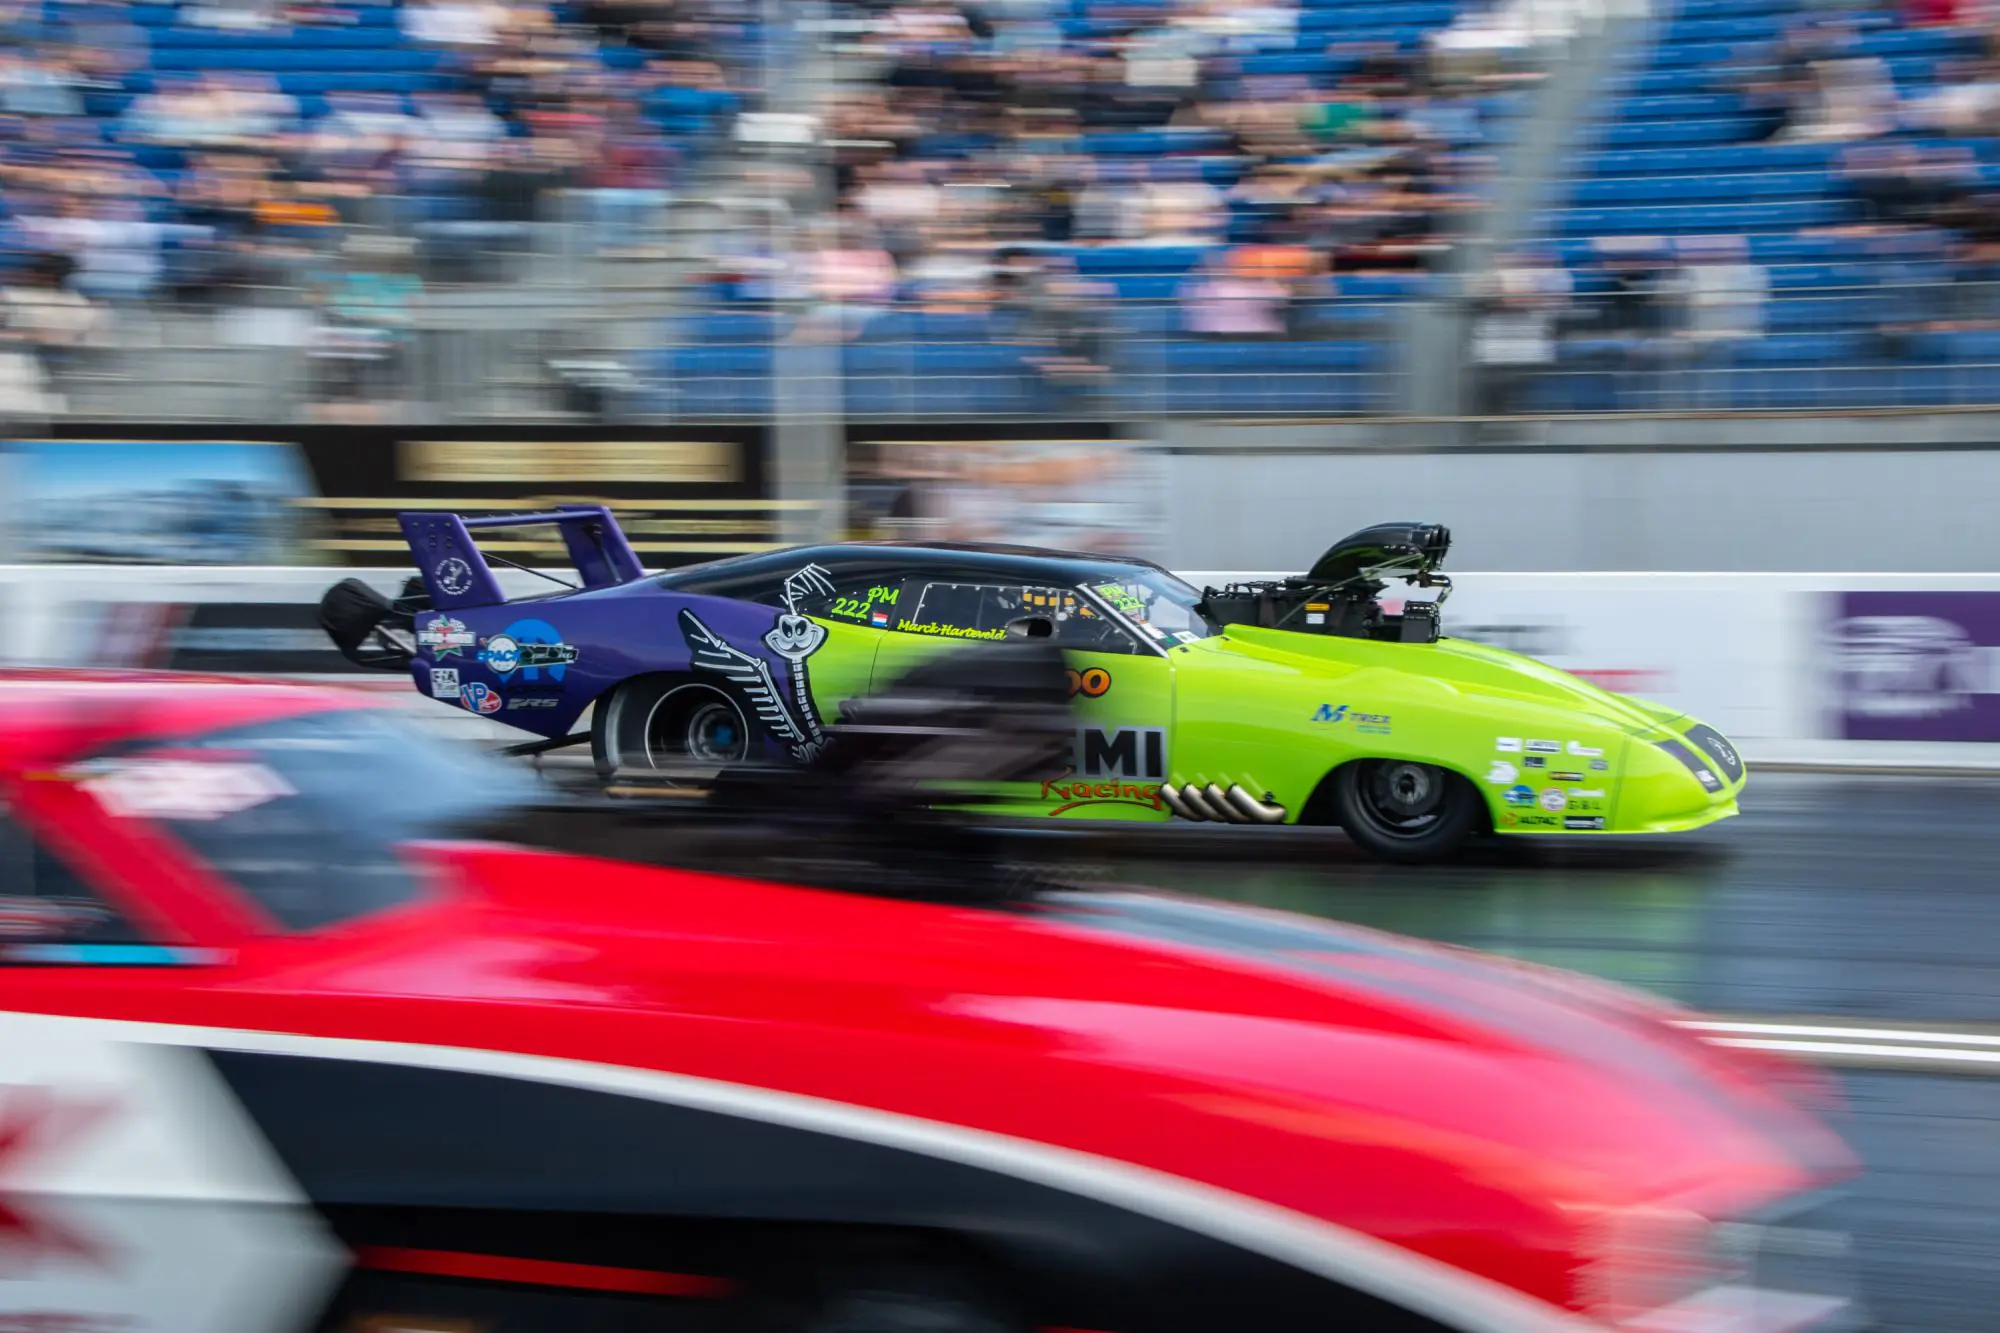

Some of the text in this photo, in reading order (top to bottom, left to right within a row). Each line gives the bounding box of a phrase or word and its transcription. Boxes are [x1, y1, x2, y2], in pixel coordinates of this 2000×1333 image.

[867, 586, 900, 605] PM
[831, 597, 872, 620] 222
[1041, 767, 1164, 811] Racing
